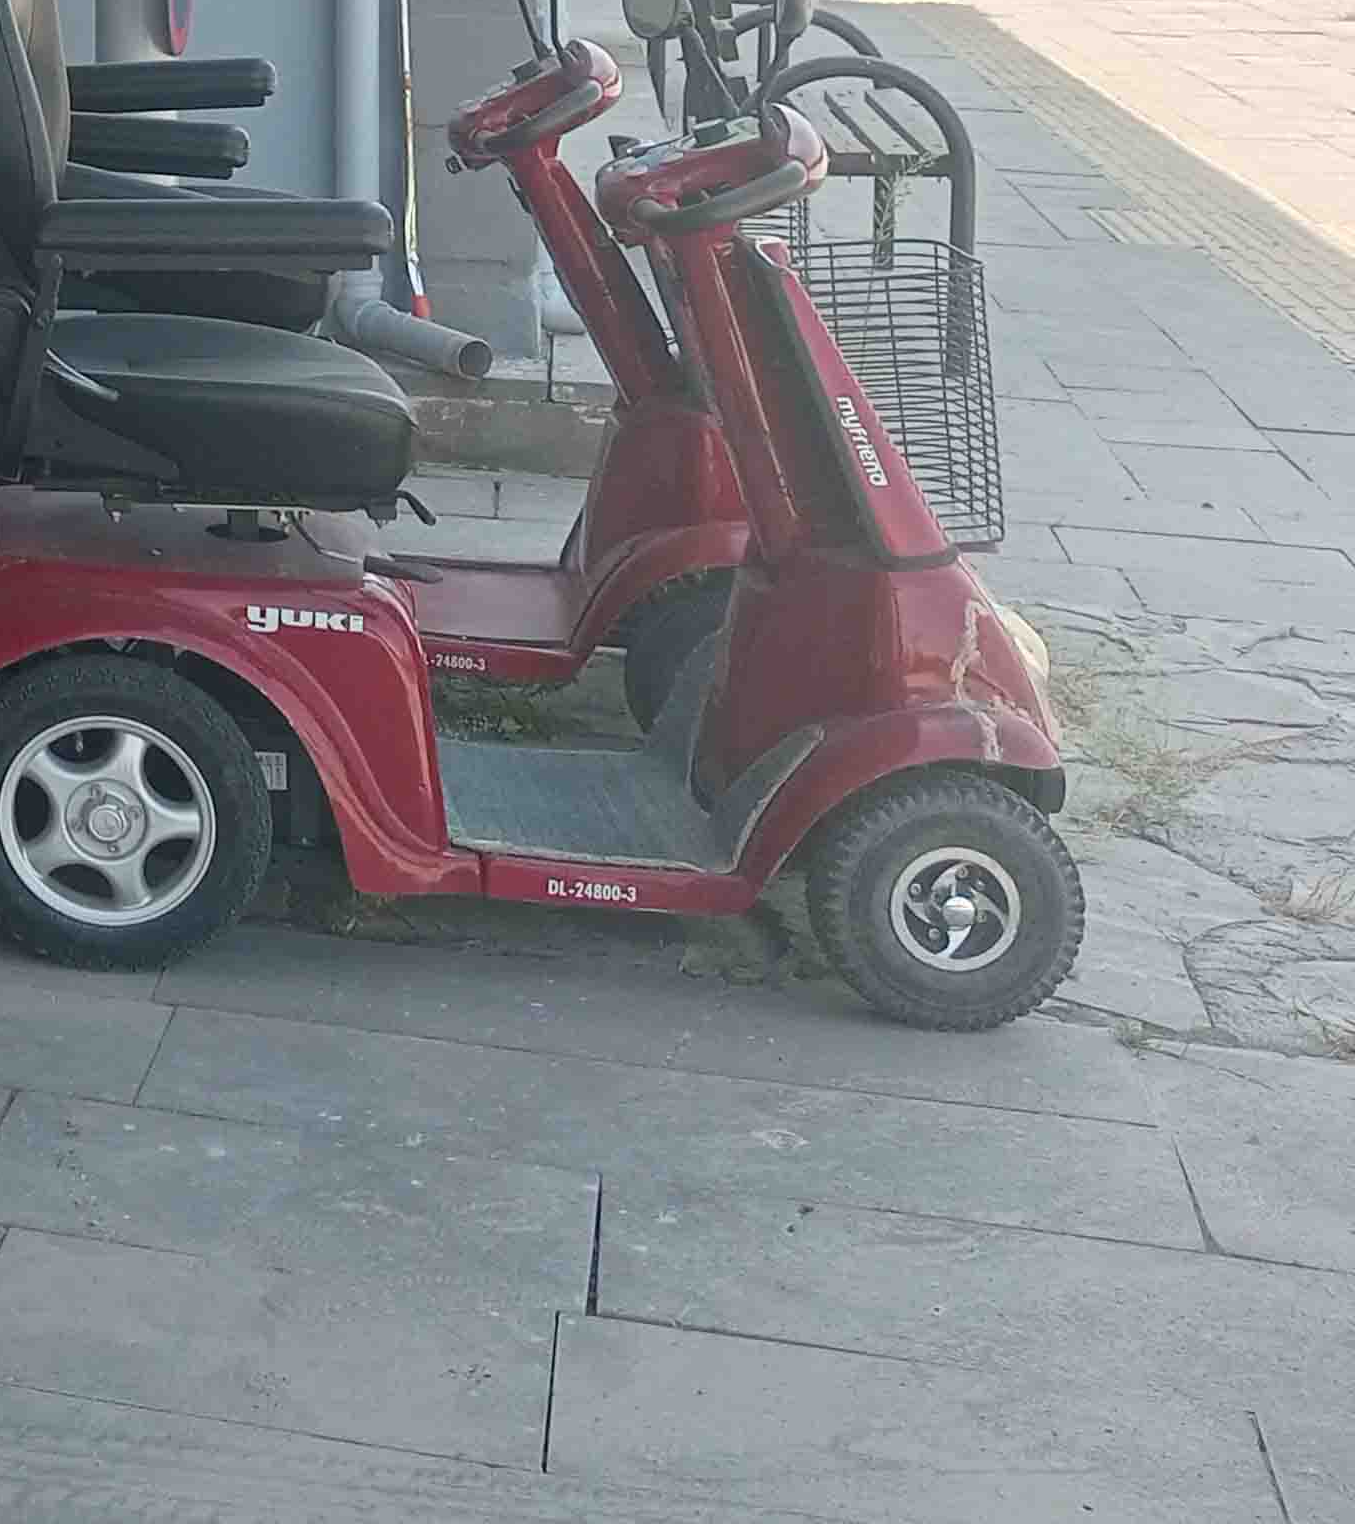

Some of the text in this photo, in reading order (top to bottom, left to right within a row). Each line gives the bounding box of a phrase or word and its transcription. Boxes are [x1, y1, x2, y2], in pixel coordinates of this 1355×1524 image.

[836, 396, 889, 486] myfriend
[422, 652, 486, 671] L-24800-3
[547, 879, 636, 902] DL-24800-3
